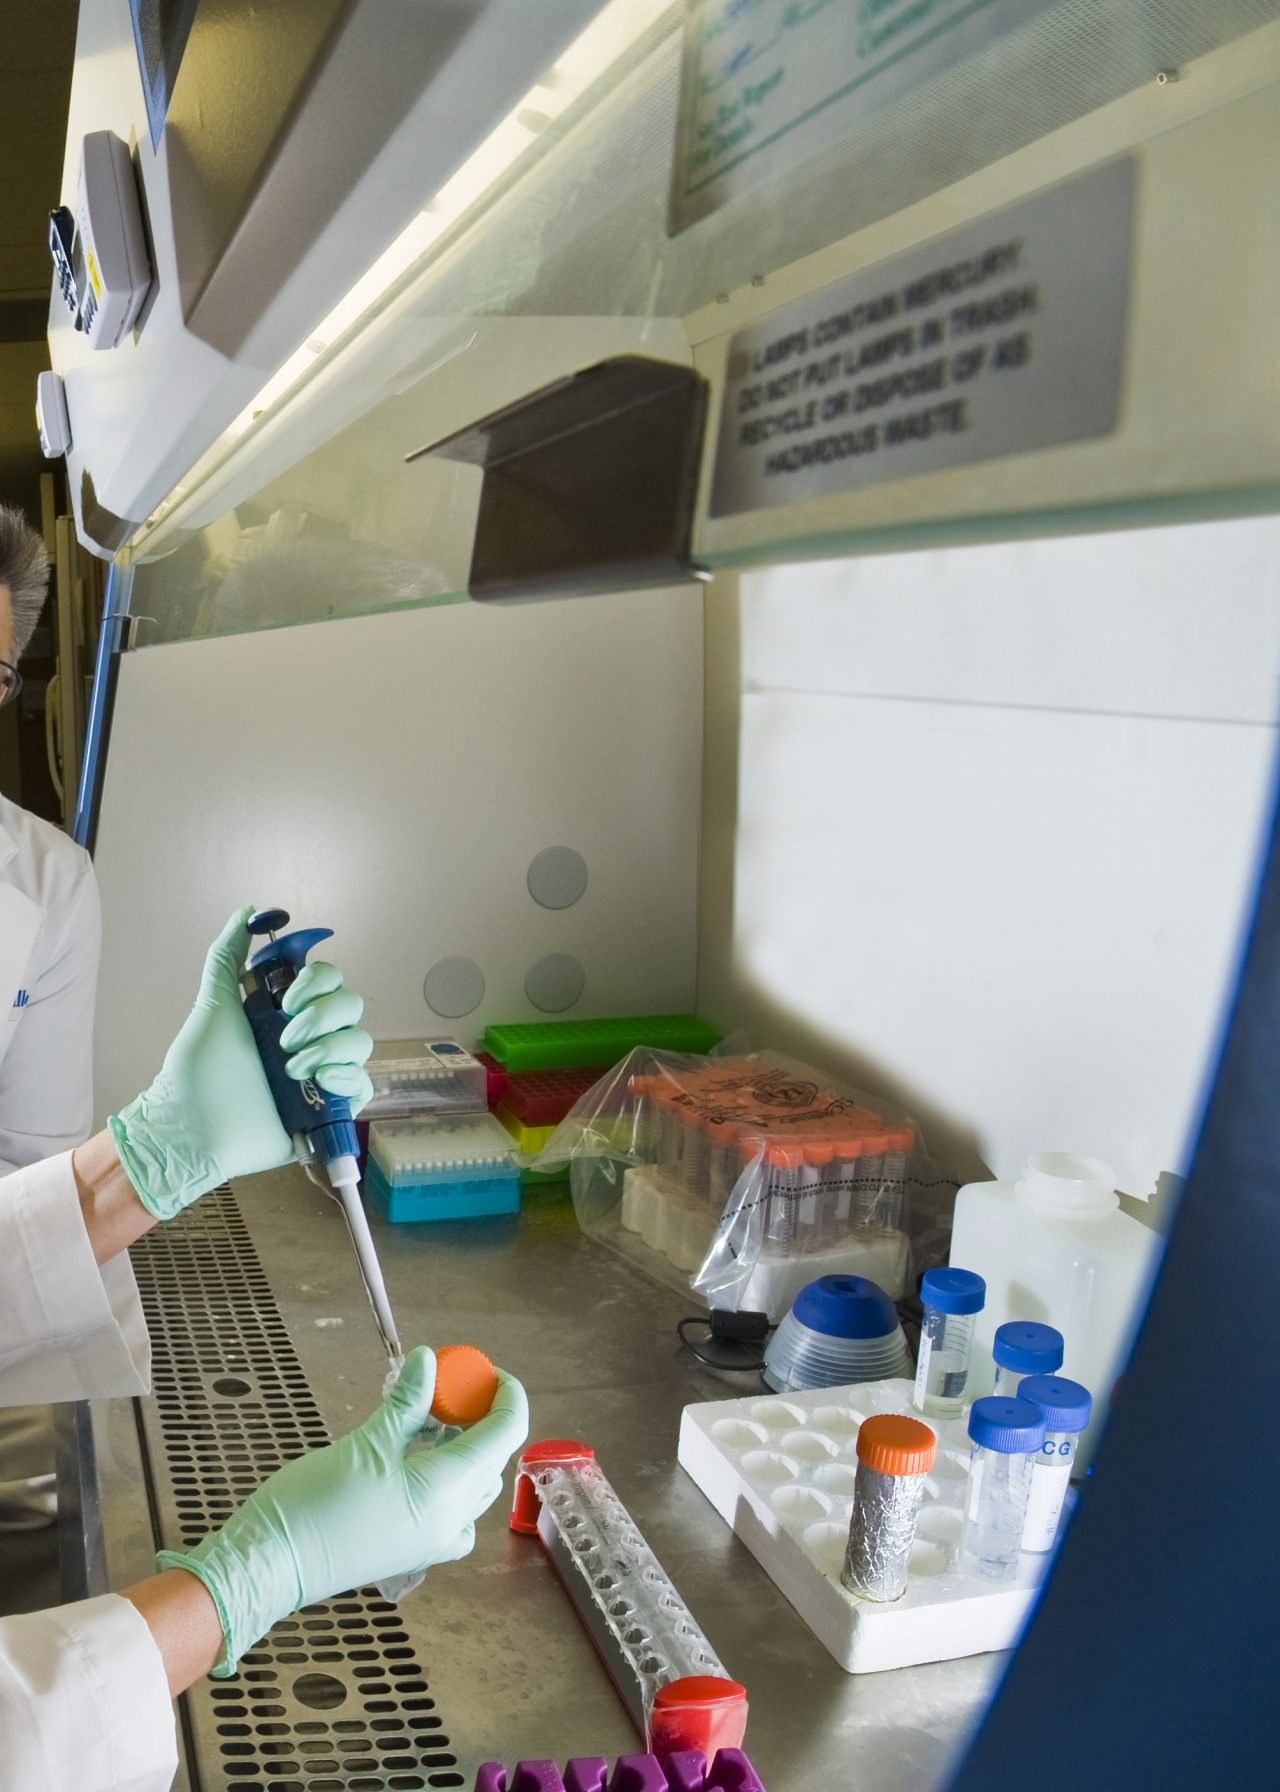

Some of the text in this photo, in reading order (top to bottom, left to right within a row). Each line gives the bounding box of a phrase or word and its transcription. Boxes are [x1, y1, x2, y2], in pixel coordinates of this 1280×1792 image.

[738, 284, 1038, 414] DO NOT PUT LAMPS IN TRASH
[752, 329, 808, 373] LAMPS
[811, 291, 898, 347] CONTAIN
[738, 330, 1031, 446] RECYCLE OR DISPOSE OF AS
[765, 423, 879, 475] HAZARDOUS
